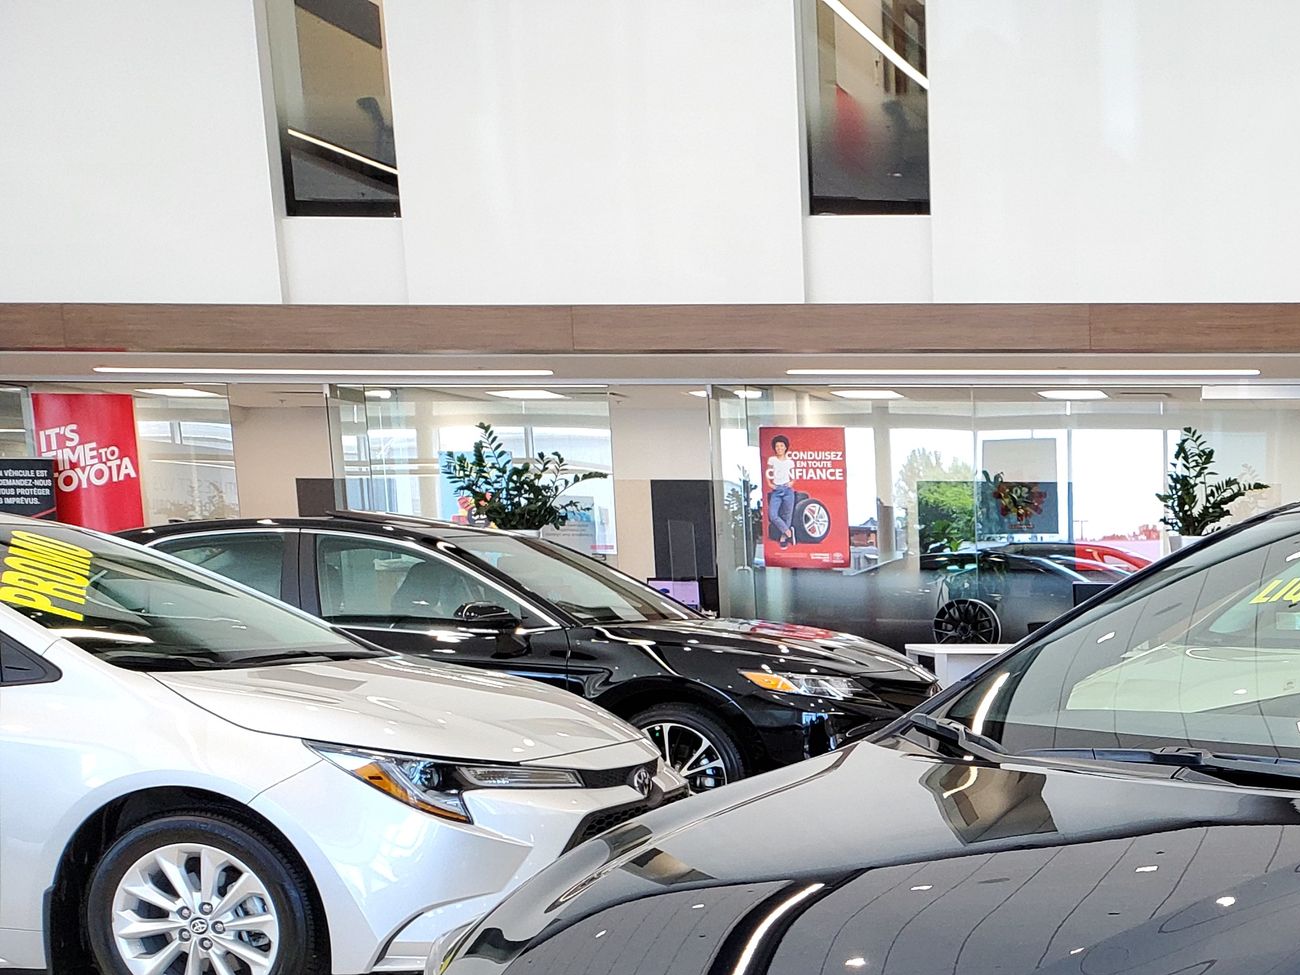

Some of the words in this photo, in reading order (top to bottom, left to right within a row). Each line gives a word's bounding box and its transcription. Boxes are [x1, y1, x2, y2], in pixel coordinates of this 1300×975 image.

[39, 424, 79, 452] IT'S
[99, 446, 119, 462] TO
[785, 451, 843, 460] CONDUISEZ
[4, 469, 35, 477] VÉHICULE
[53, 457, 137, 492] OYOTA
[765, 469, 843, 480] CNFIANCE
[16, 488, 50, 496] PROTÉGER
[0, 530, 93, 621] PROMO
